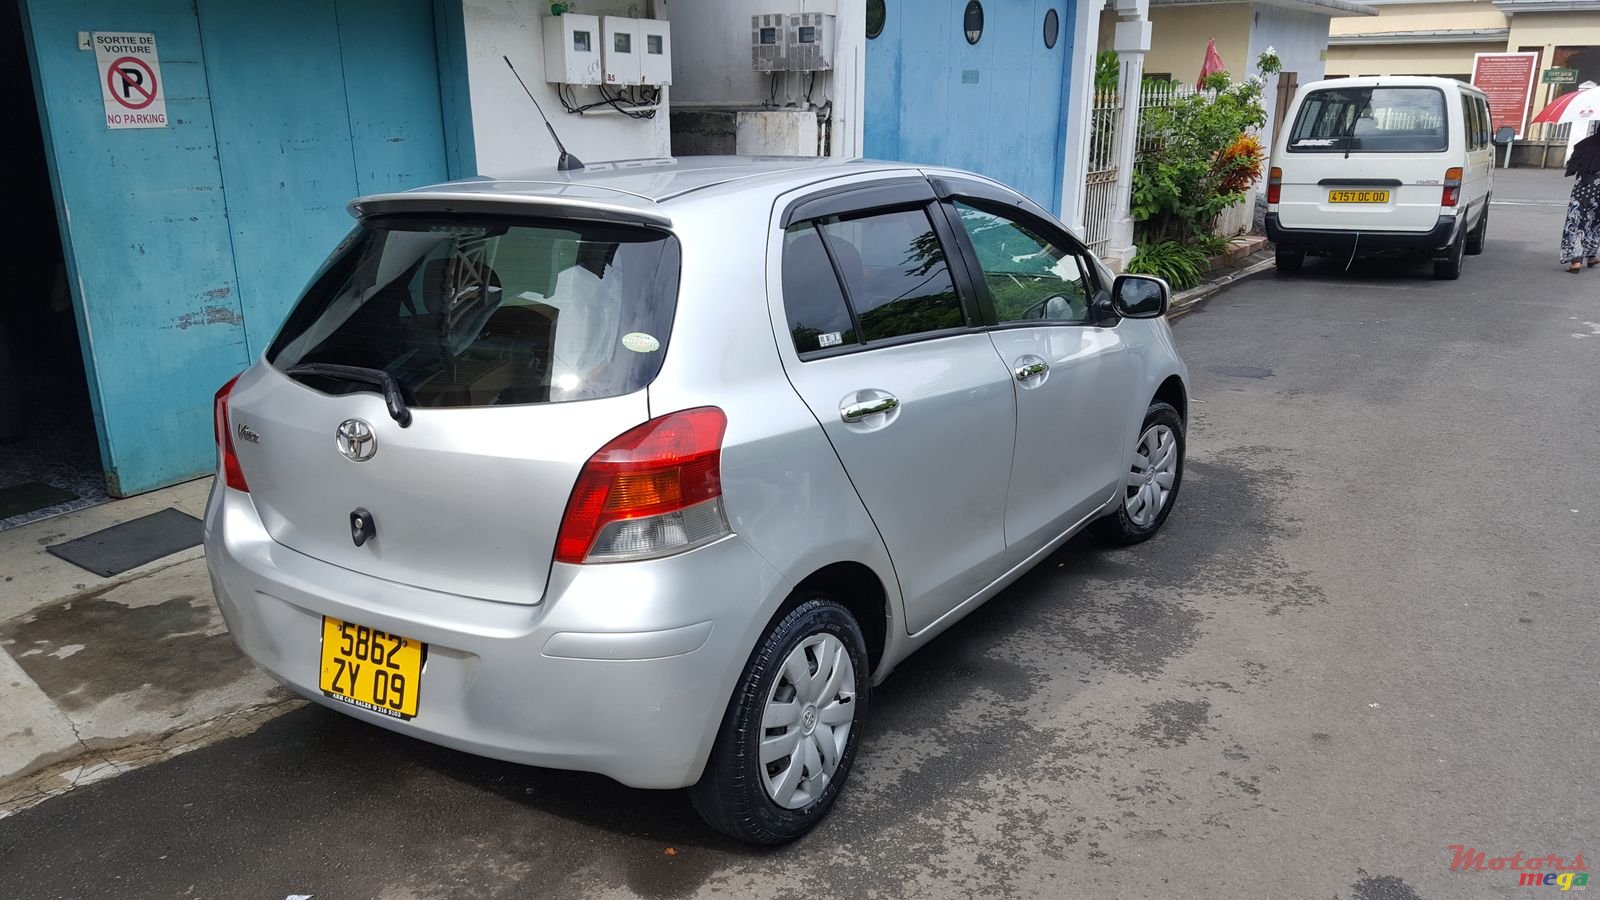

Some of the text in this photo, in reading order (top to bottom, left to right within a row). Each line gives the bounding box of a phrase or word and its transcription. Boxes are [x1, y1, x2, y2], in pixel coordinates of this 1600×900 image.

[96, 36, 137, 44] SORTIE
[104, 46, 151, 54] VOITURE
[108, 114, 165, 124] NO PARKING
[1332, 192, 1356, 201] 4757
[340, 620, 402, 670] 5862
[332, 657, 406, 710] ZY 09
